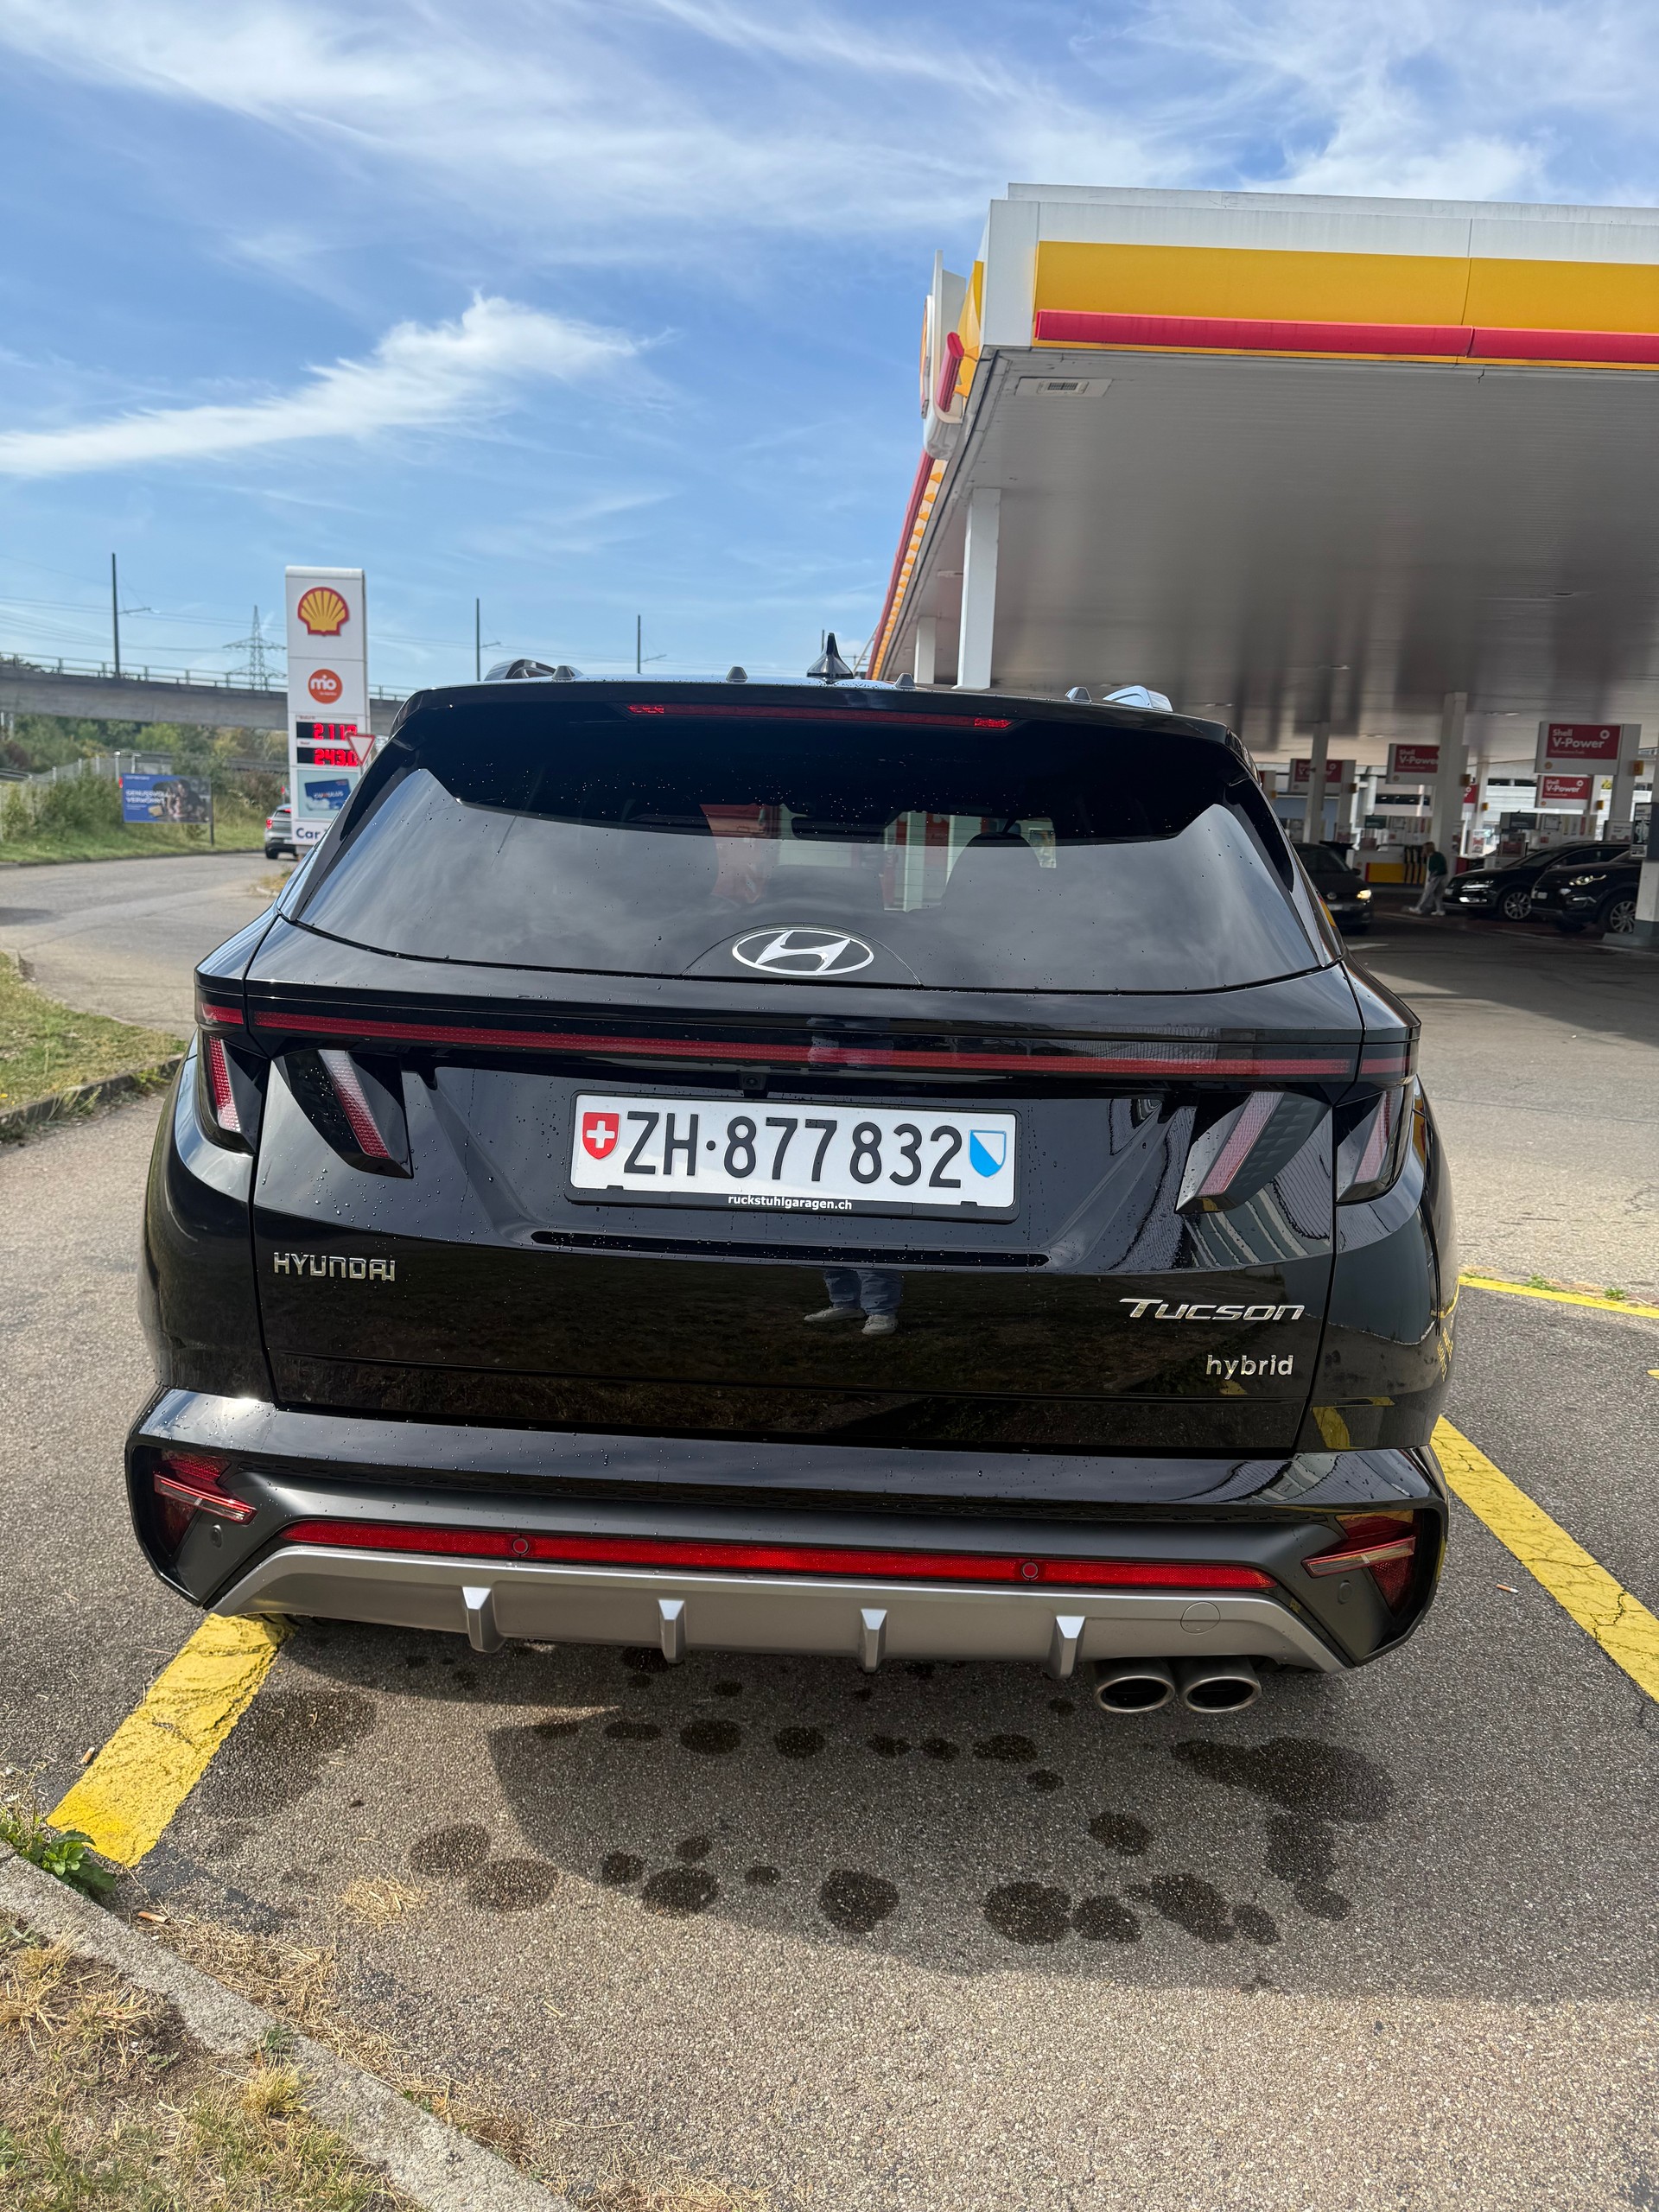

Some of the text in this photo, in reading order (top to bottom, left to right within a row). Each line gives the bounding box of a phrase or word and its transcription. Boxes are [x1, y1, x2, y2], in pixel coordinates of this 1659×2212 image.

[1552, 728, 1573, 737] Shell
[1552, 737, 1605, 749] V-Power
[1399, 755, 1439, 765] V-Powe
[296, 827, 321, 839] Car
[728, 1195, 852, 1210] ruckstuhlgaragen.ch
[273, 1252, 395, 1281] HYUNDAI
[1205, 1354, 1294, 1380] hybrid
